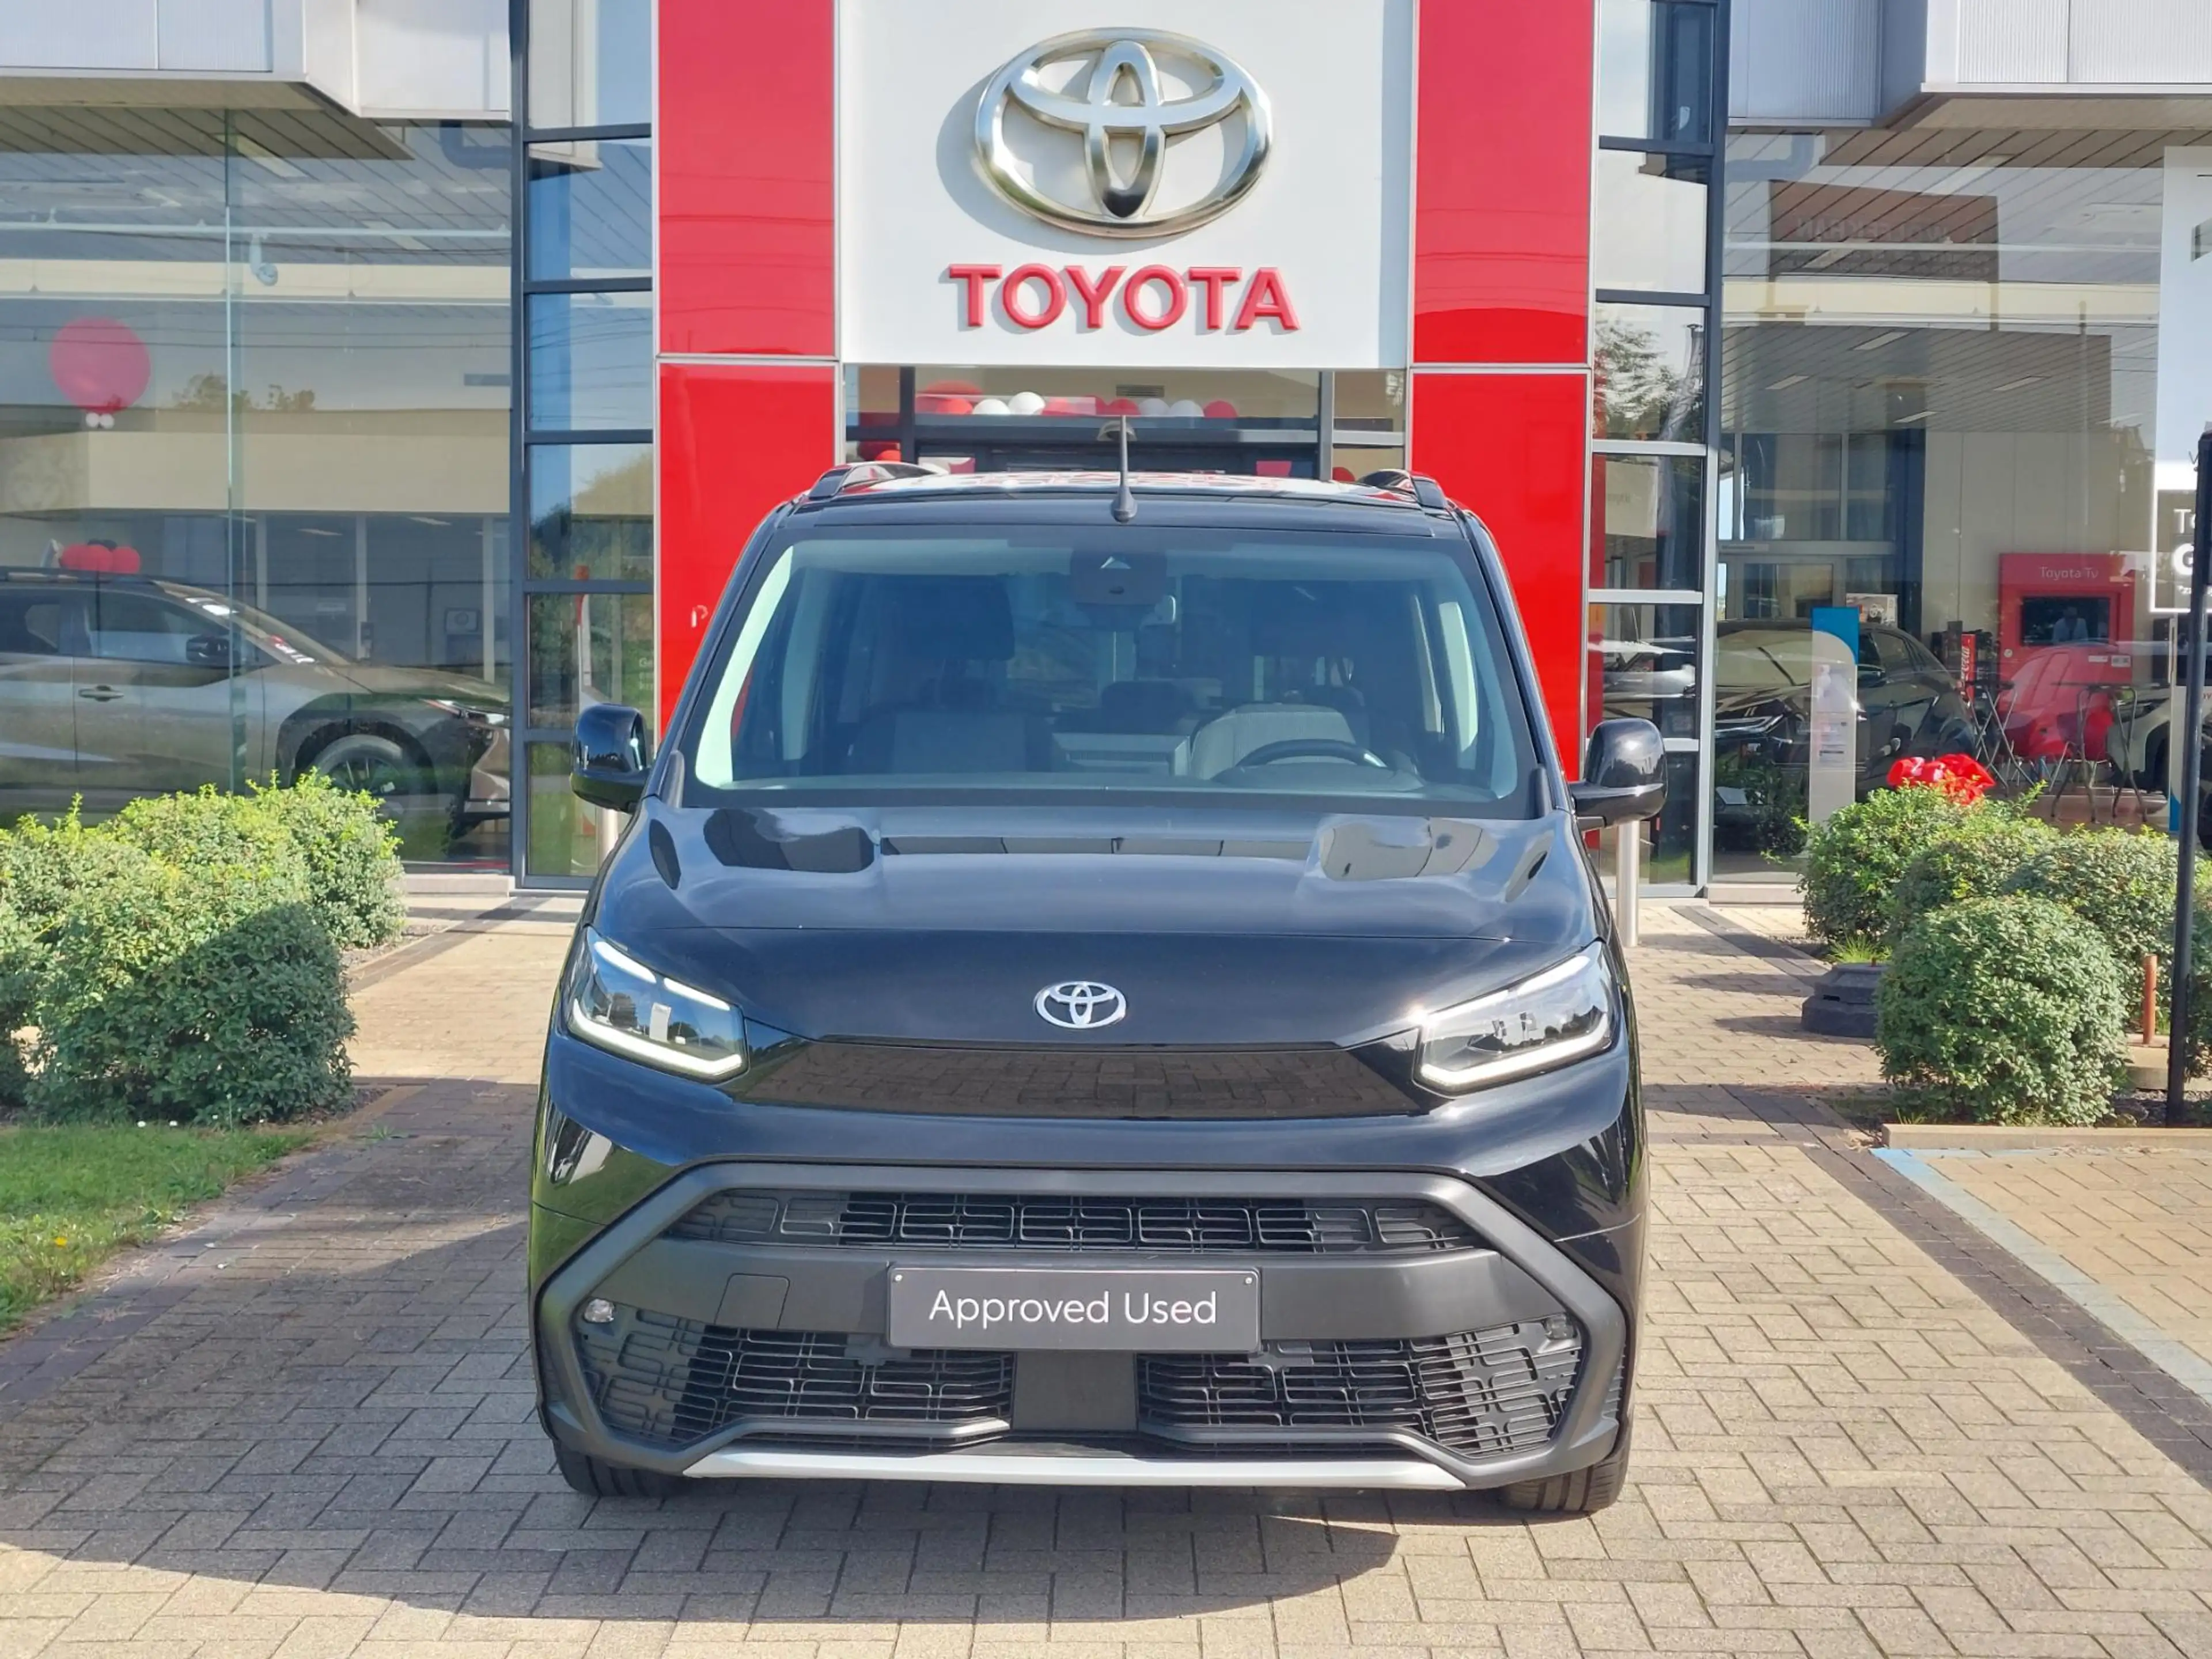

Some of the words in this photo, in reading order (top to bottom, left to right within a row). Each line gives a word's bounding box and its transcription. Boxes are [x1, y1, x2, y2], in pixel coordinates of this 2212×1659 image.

[948, 263, 1301, 330] TOYOTA
[2038, 566, 2081, 581] Toyota
[2082, 567, 2100, 579] Tv
[929, 1289, 1109, 1330] Approved
[1124, 1291, 1217, 1324] Used
